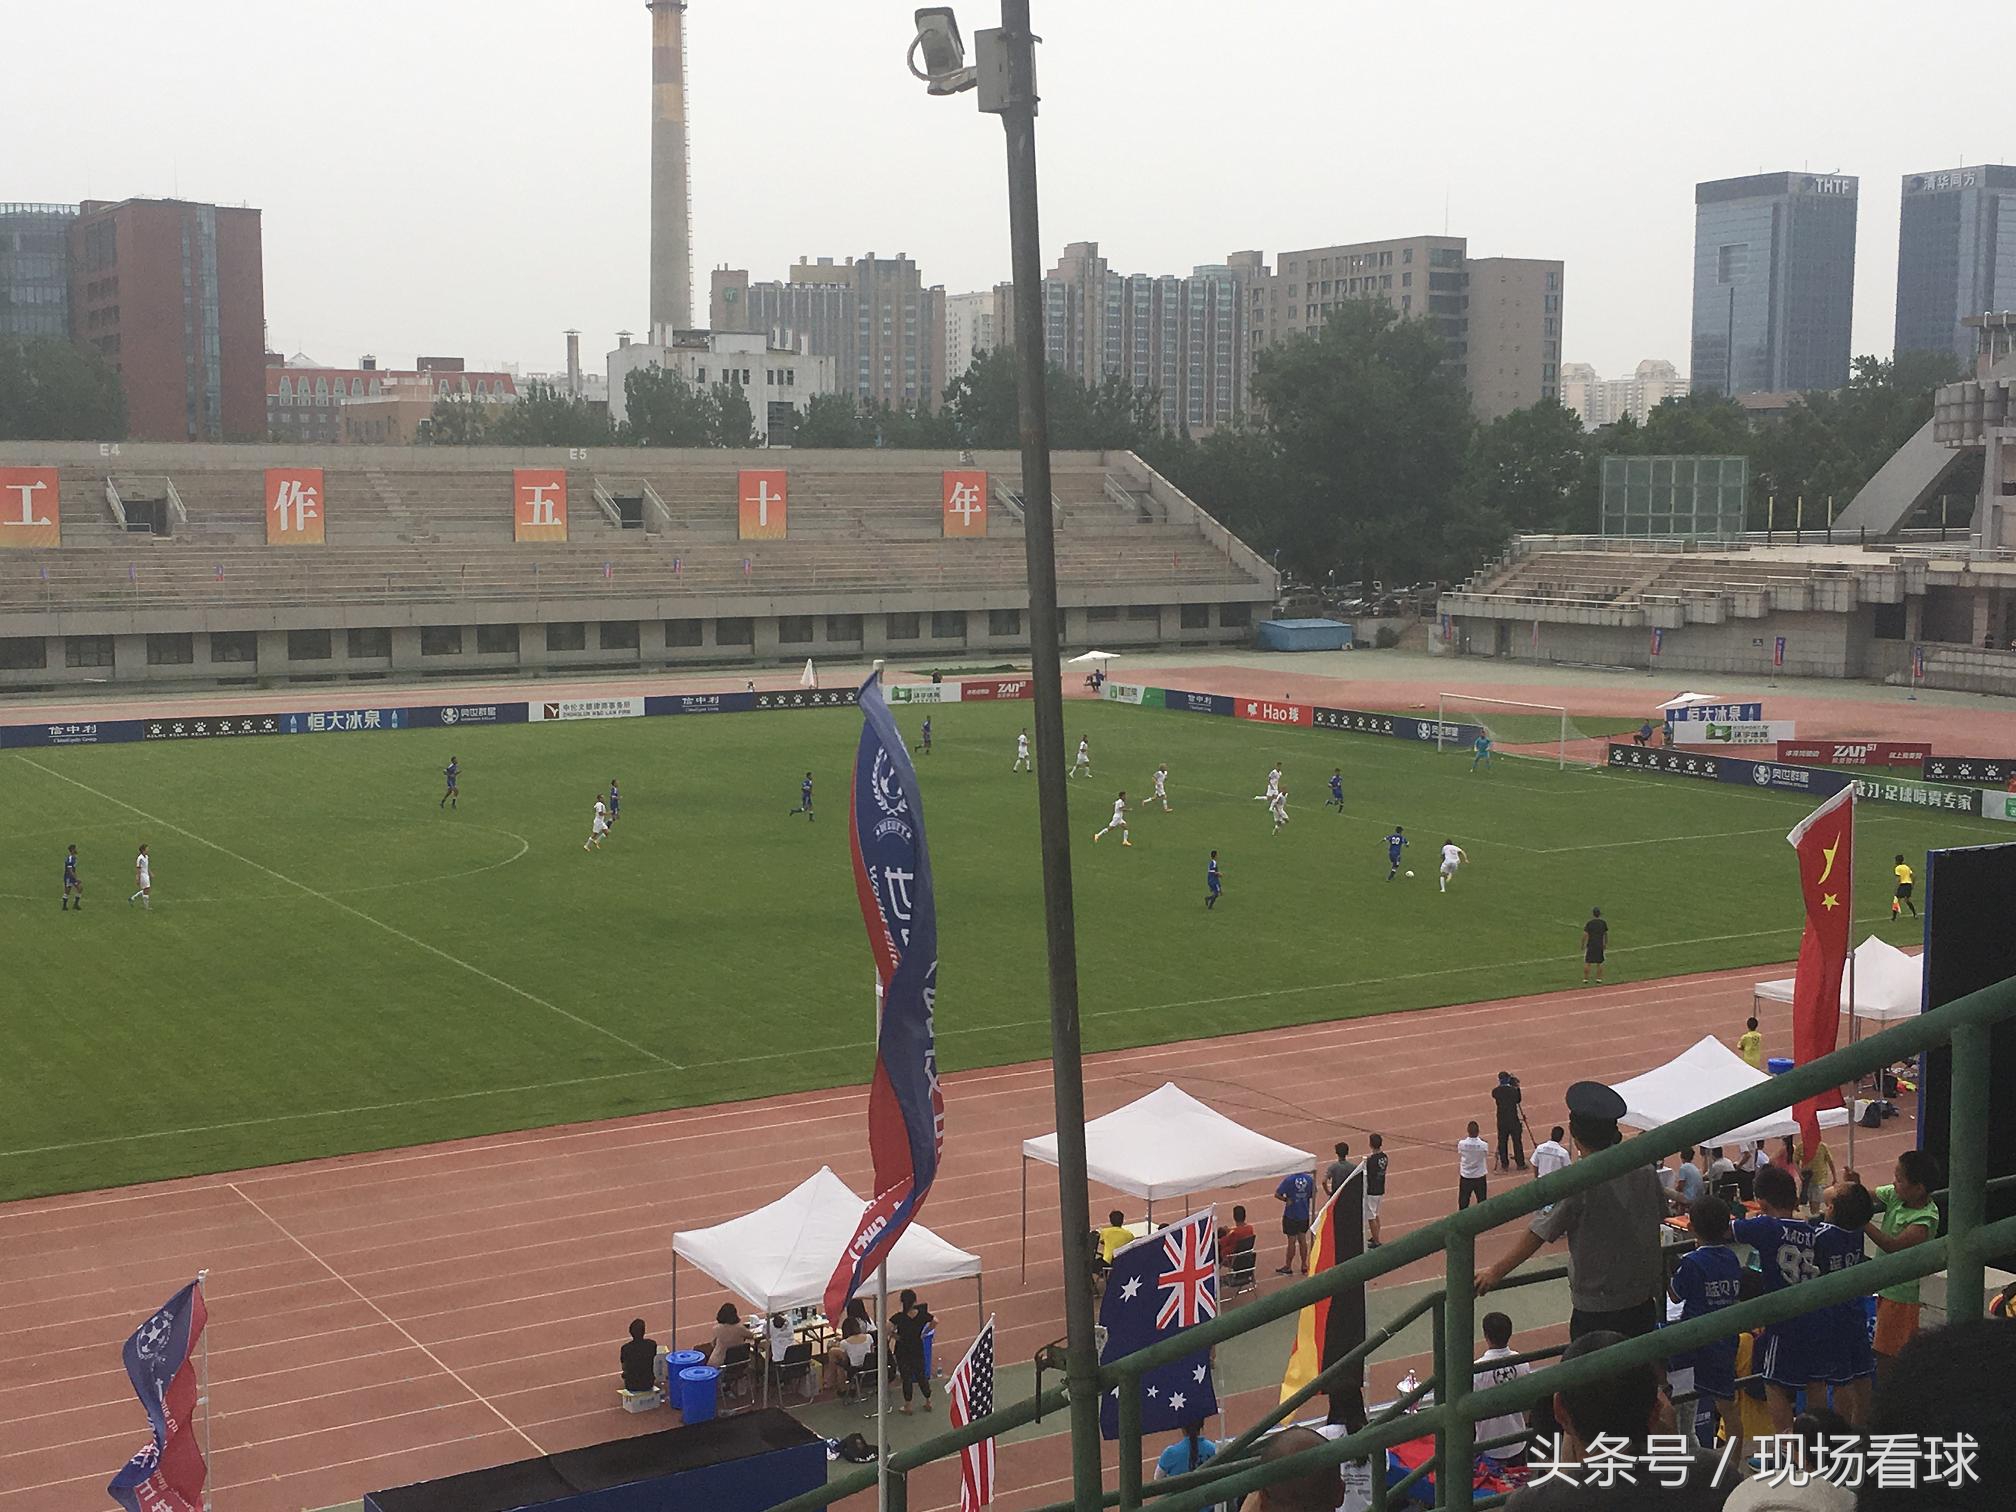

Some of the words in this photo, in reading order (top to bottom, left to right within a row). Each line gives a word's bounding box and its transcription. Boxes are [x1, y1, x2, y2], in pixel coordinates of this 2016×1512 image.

[1815, 177, 1850, 195] THTF
[1923, 172, 1976, 191] 清华同方
[100, 443, 120, 457] E4
[569, 448, 587, 461] E5
[3, 480, 52, 525] 工
[273, 480, 318, 531] 作
[522, 482, 562, 525] 五
[745, 480, 782, 527] 十
[948, 481, 982, 526] 年
[307, 710, 382, 732] 恒大冰泉
